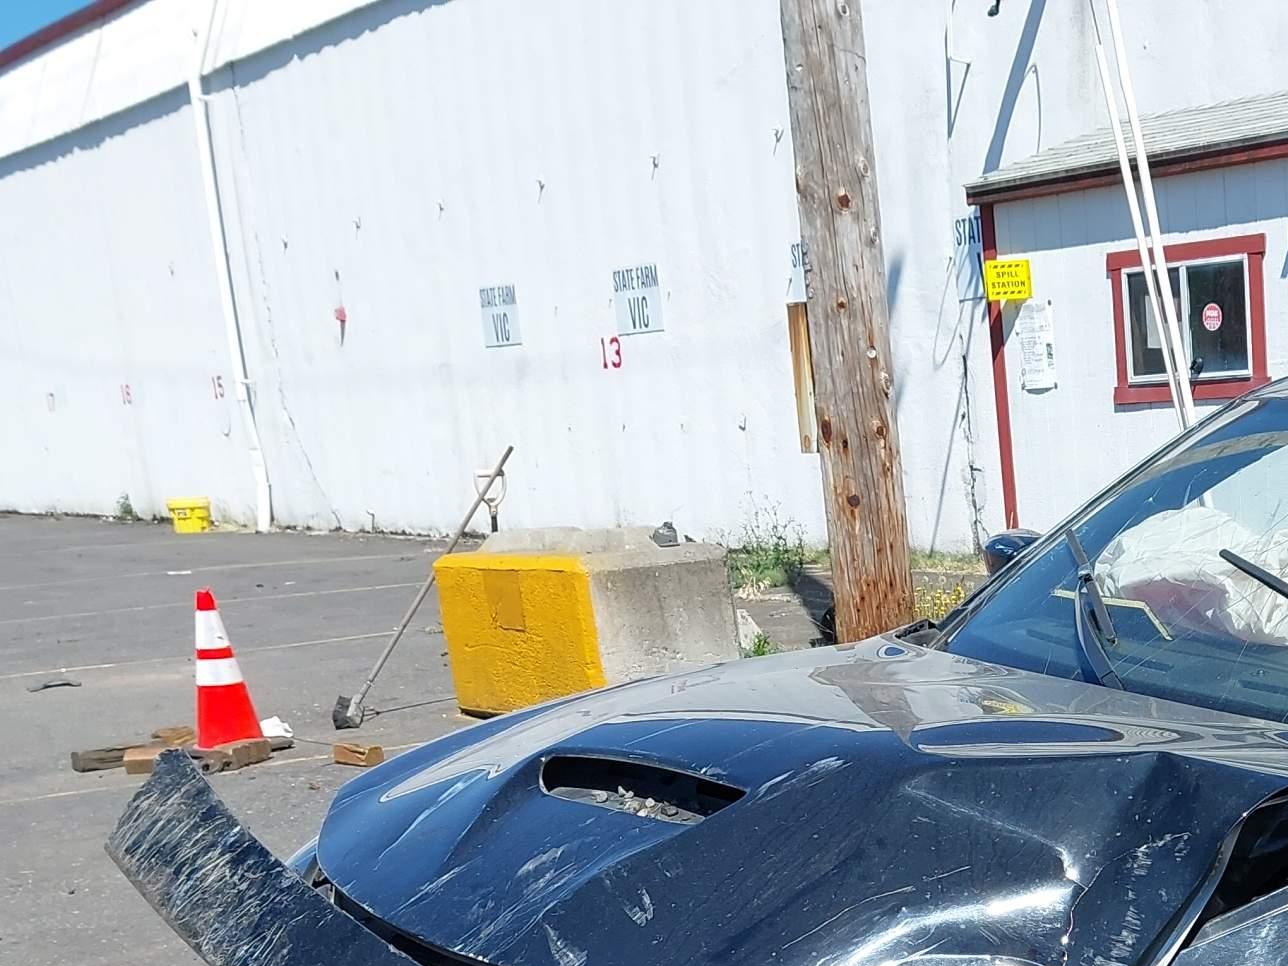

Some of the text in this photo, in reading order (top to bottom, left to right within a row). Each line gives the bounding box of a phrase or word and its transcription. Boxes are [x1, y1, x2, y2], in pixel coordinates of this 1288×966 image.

[955, 216, 981, 246] STAT
[613, 264, 659, 292] STATE FARM
[991, 280, 1026, 289] STATION
[479, 284, 517, 309] STATE FARM
[628, 295, 650, 329] VIC
[492, 312, 510, 343] VIC
[601, 337, 622, 369] 13
[212, 375, 225, 400] 15
